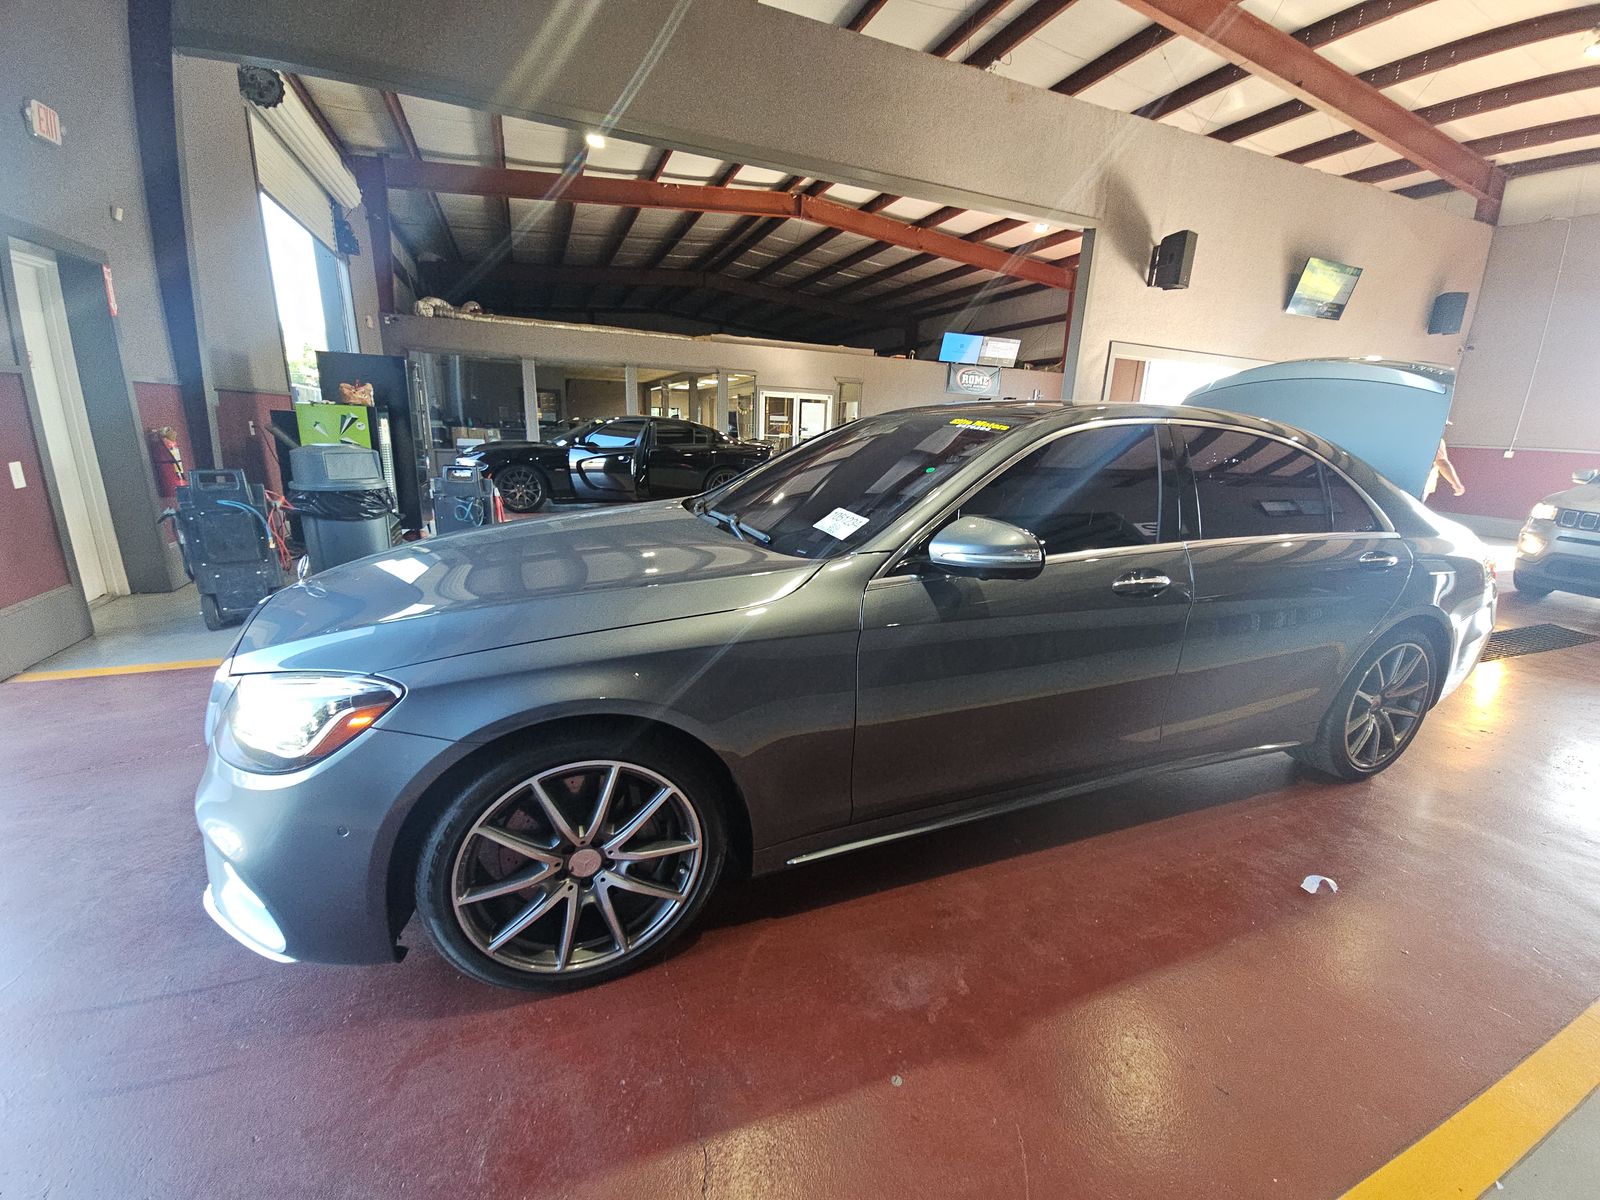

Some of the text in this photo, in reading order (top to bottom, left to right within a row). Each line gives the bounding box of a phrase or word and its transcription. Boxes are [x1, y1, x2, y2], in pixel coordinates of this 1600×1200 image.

[38, 104, 59, 141] EXIT
[961, 374, 990, 386] ROME
[972, 420, 1010, 431] Motors
